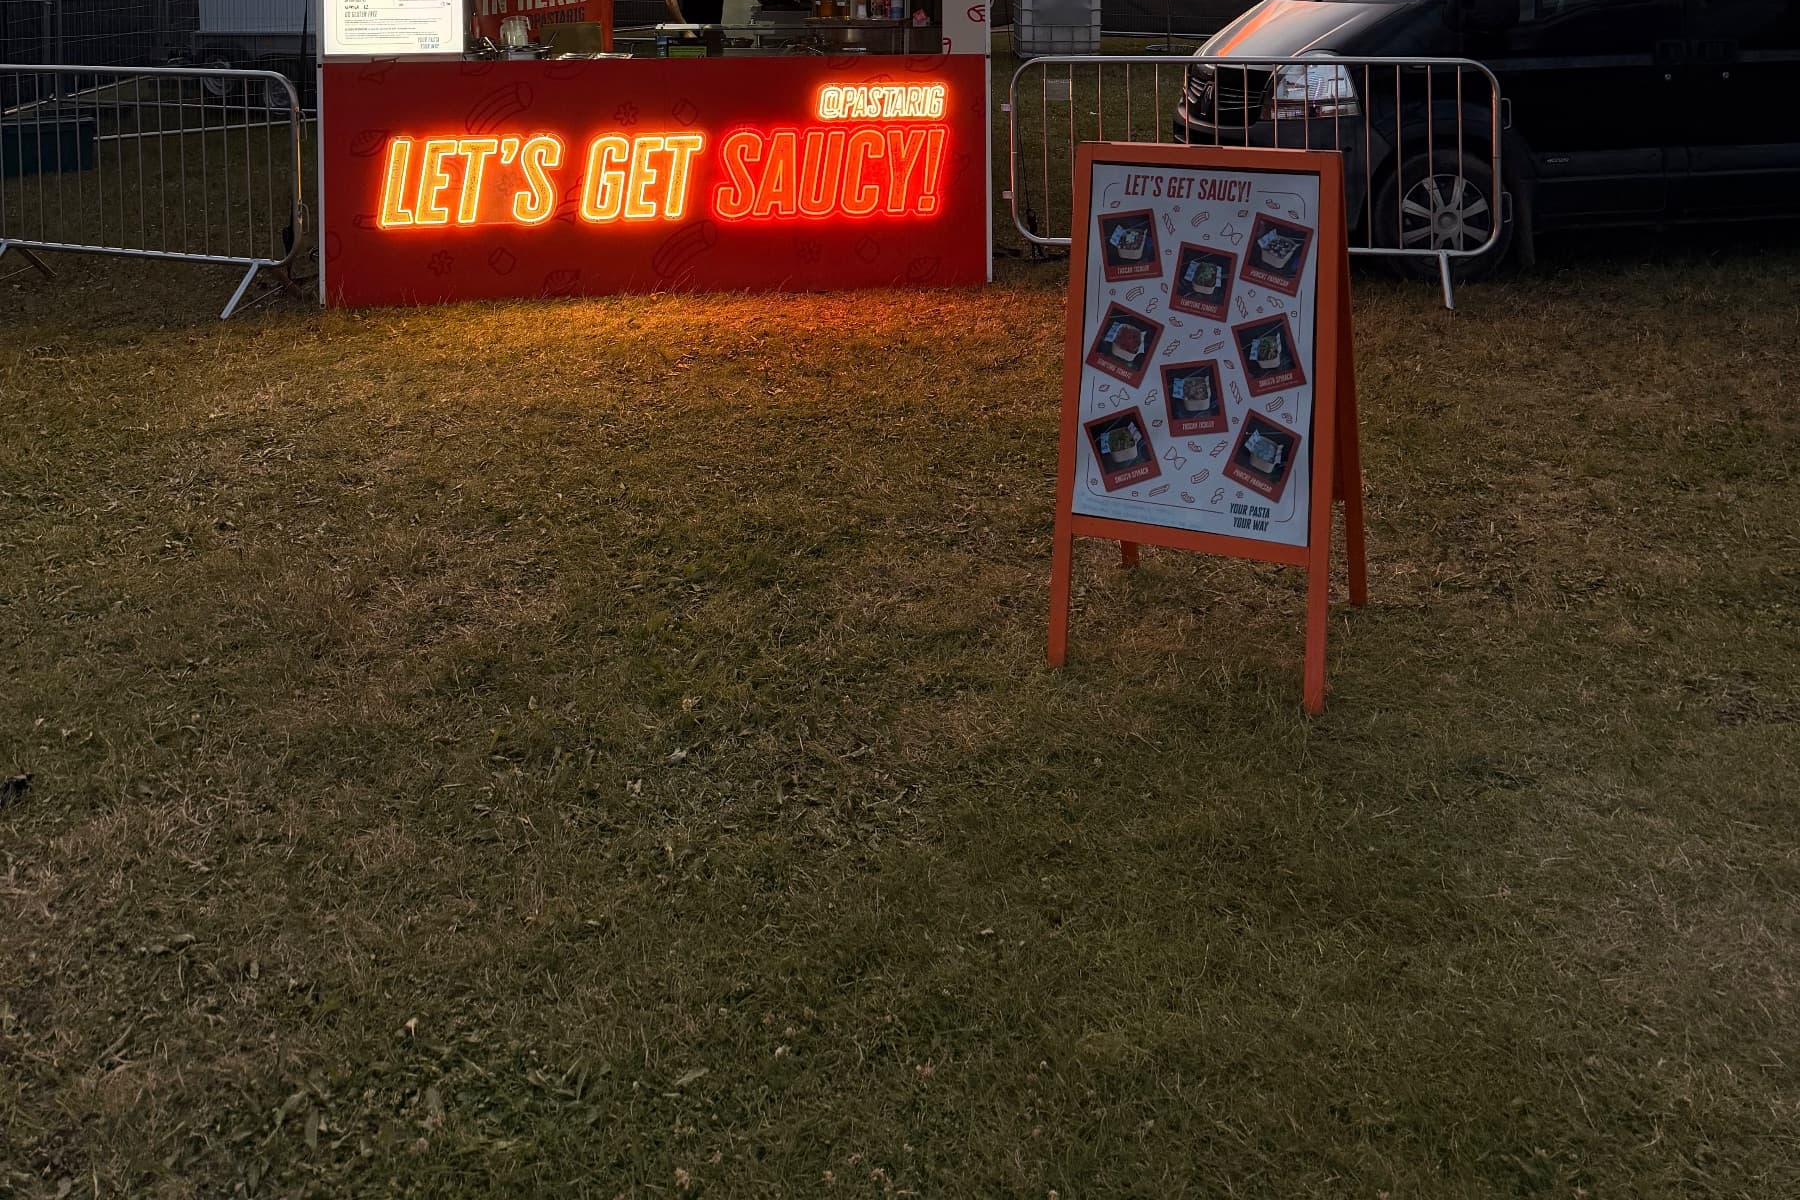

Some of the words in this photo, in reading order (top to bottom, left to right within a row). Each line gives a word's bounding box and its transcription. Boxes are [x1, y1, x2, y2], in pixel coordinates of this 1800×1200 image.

[819, 85, 945, 119] @PASTARIG
[382, 135, 562, 226] LET'S
[581, 135, 703, 220] GET
[716, 128, 945, 218] SAUCY!
[1124, 174, 1163, 197] LET'S
[1166, 176, 1195, 199] GET
[1198, 178, 1252, 203] SAUCY!
[1230, 502, 1248, 515] YOUR
[1249, 505, 1270, 519] PASTA
[1233, 517, 1251, 529] YOUR
[1253, 519, 1269, 532] WAY
